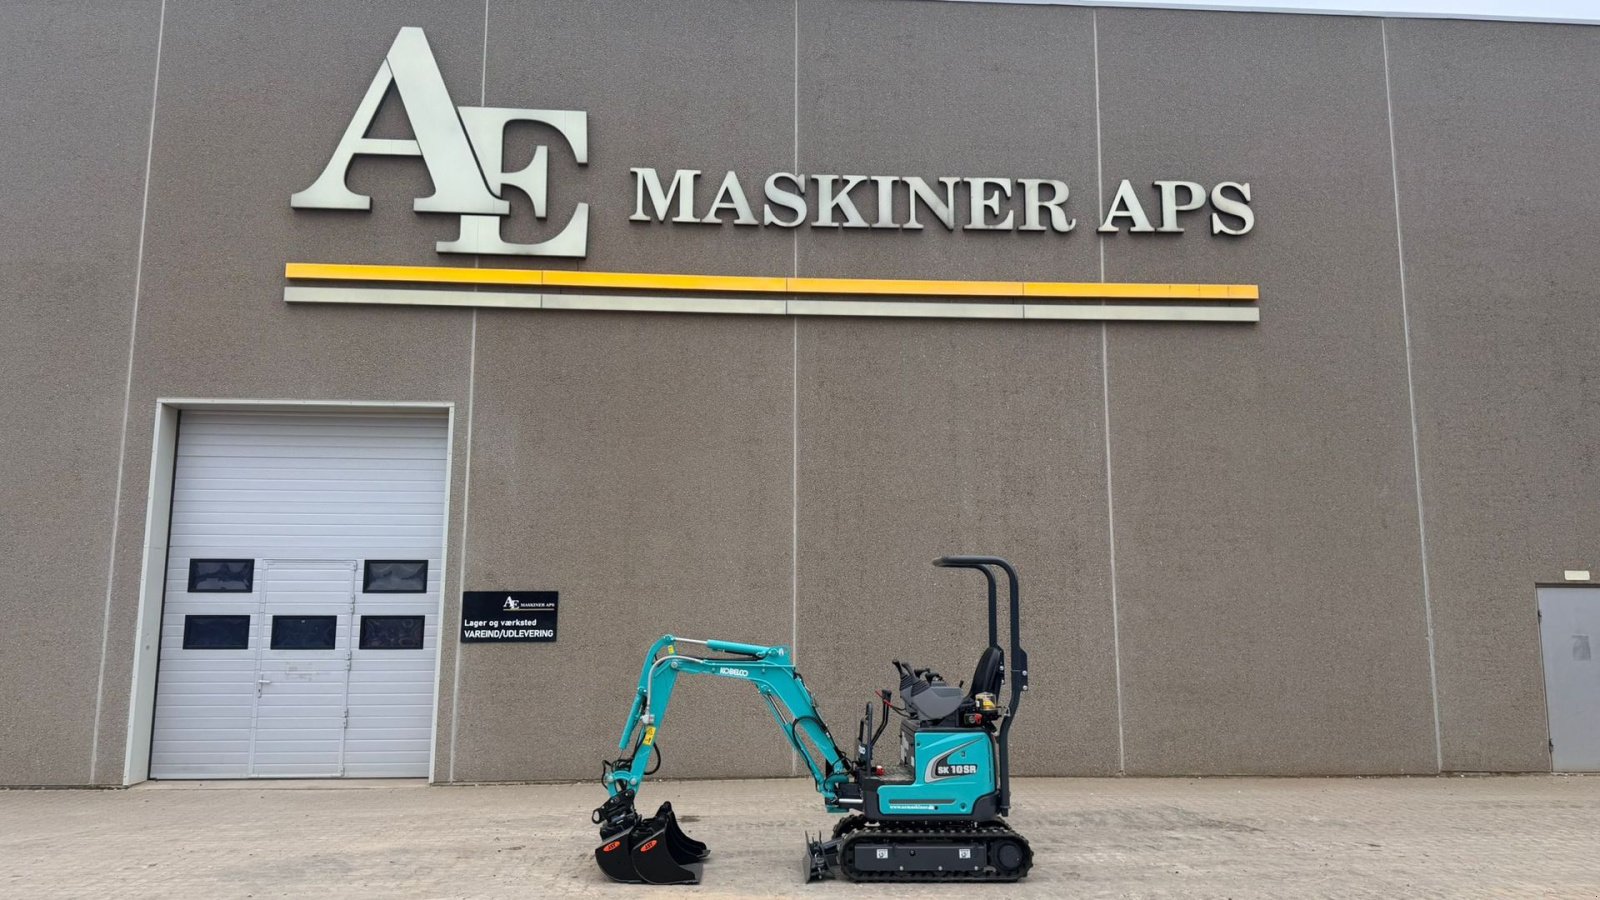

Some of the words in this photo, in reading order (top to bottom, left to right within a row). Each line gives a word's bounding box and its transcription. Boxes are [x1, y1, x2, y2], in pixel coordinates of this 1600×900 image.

[629, 167, 1077, 232] MASKINER
[1097, 179, 1255, 236] APS
[464, 619, 487, 628] Lager
[464, 630, 553, 639] VAREIND/UDLEVERING
[720, 667, 748, 676] KOBELCO
[937, 766, 950, 774] SK
[951, 765, 977, 773] 10SR
